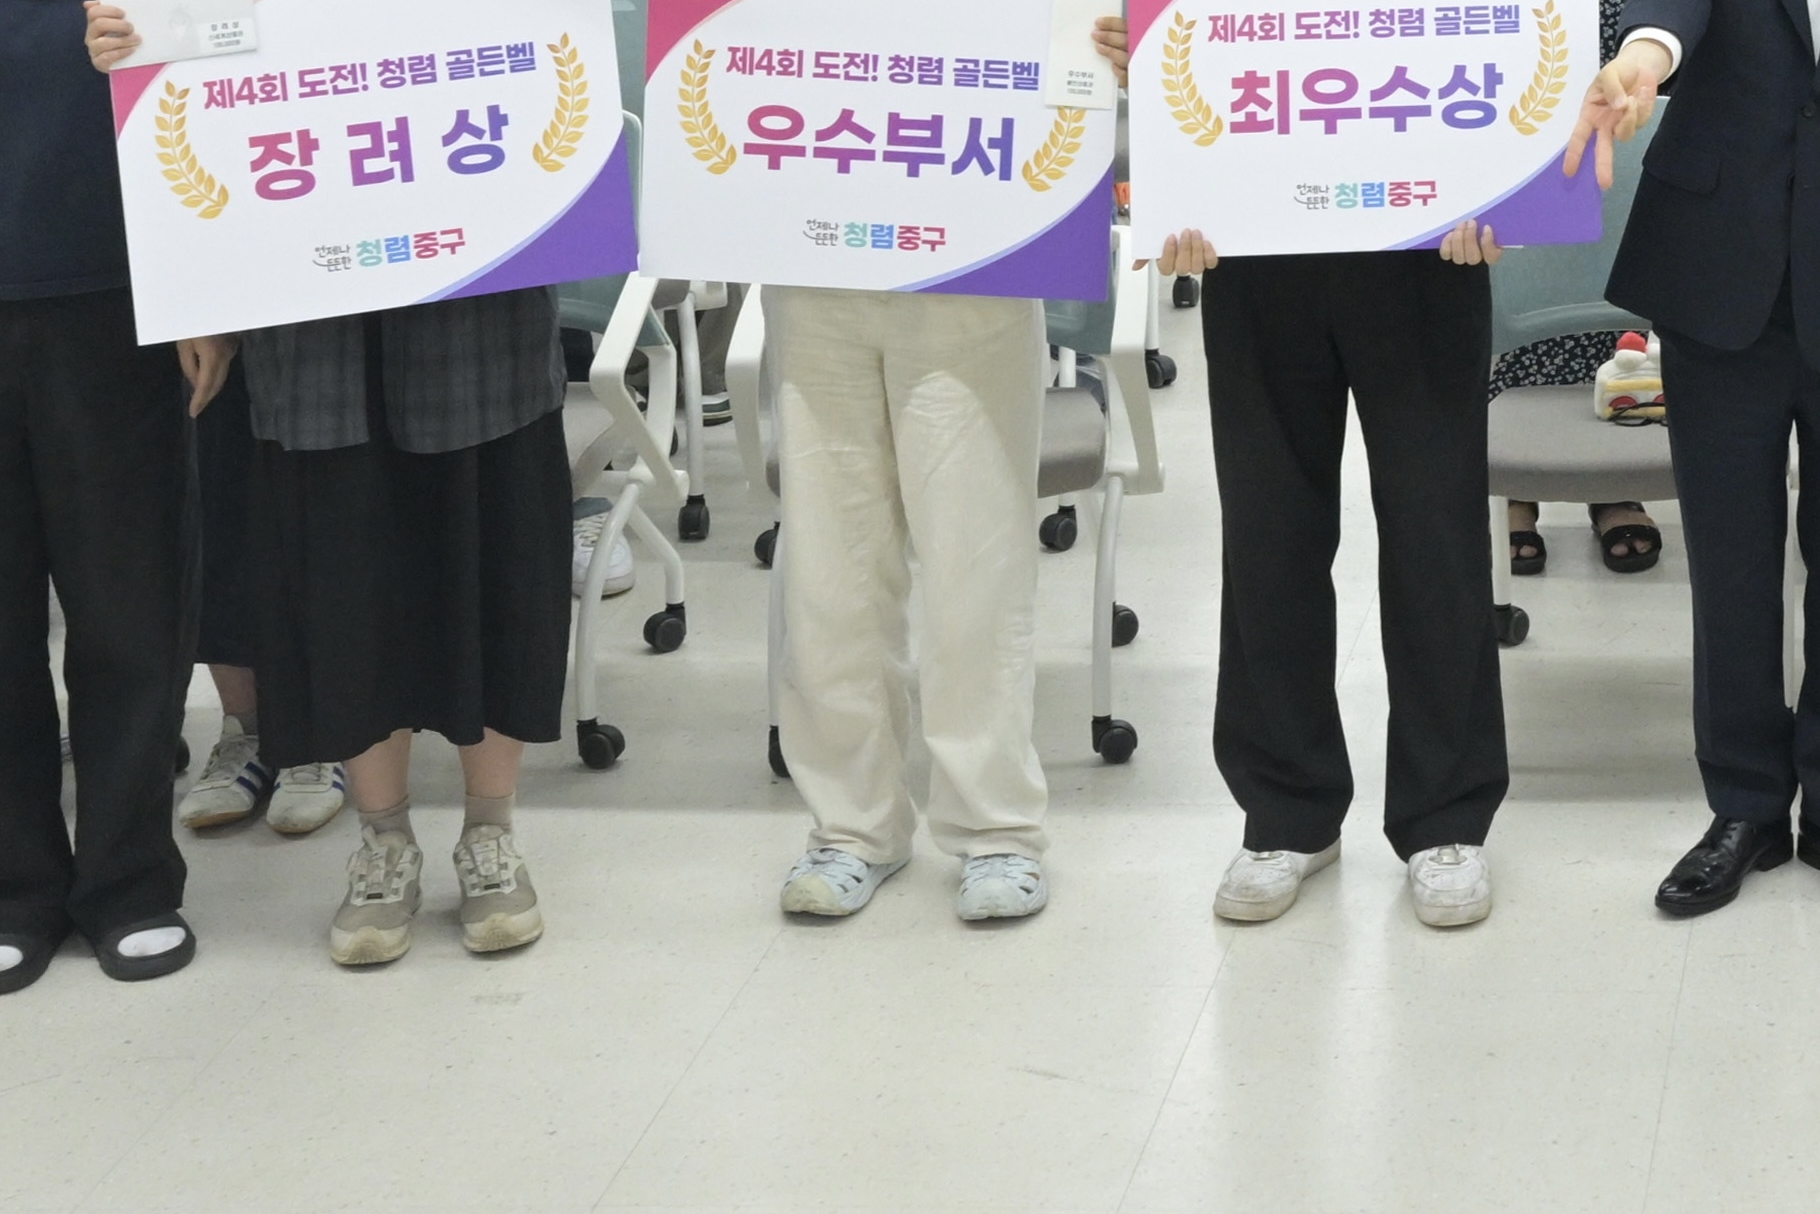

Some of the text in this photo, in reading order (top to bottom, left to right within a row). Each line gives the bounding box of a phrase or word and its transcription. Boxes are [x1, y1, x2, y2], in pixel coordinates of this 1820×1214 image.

[1208, 5, 1520, 43] 제4회 도전! 청렴 골든벨
[203, 42, 536, 109] 제4회 도전! 청렴 골든벨
[726, 46, 1040, 91] 제4회 도전! 청렴 골든벨
[1230, 63, 1504, 135] 최우수상
[743, 105, 1015, 181] 우수부서
[1296, 183, 1329, 195] 언제나
[1335, 181, 1437, 208] 청렴중구
[806, 219, 839, 231] 언제나
[844, 222, 946, 252] 청렴중구
[315, 244, 351, 258] 언제나
[357, 228, 465, 266] 청렴중구
